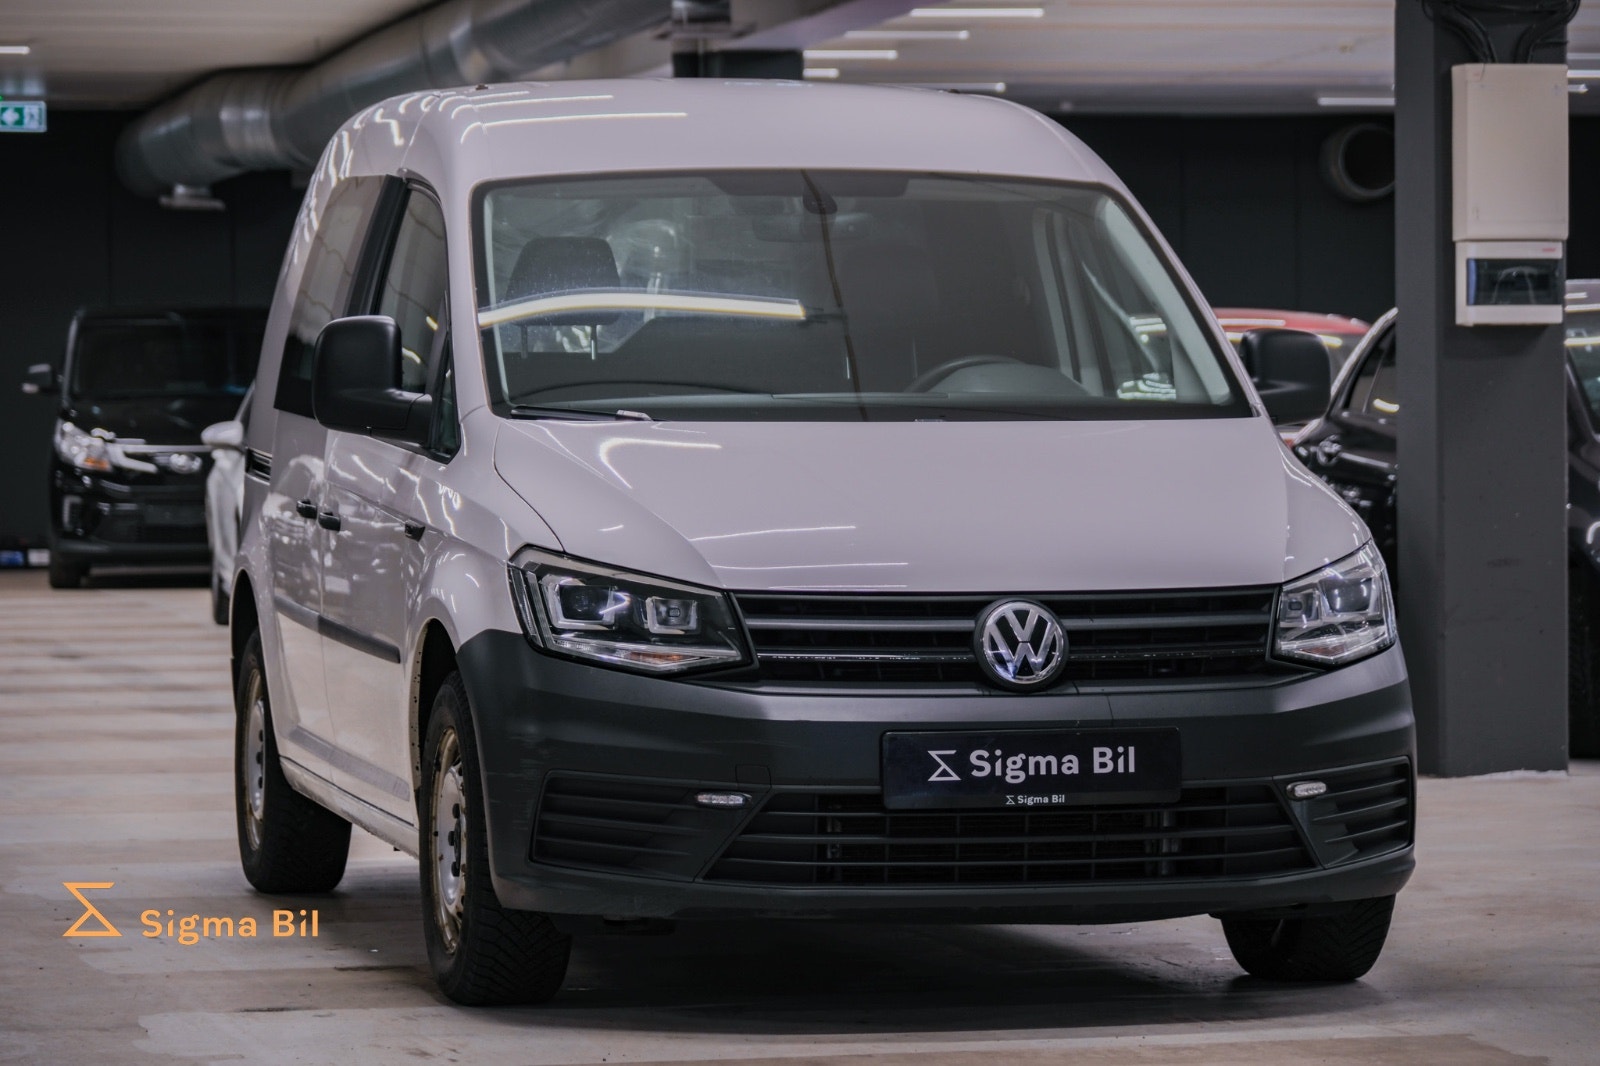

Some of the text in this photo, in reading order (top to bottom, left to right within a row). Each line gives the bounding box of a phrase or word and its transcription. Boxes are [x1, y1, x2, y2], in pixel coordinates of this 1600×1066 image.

[969, 746, 1136, 784] Sigma Bil
[1017, 794, 1065, 805] Sigma Bil
